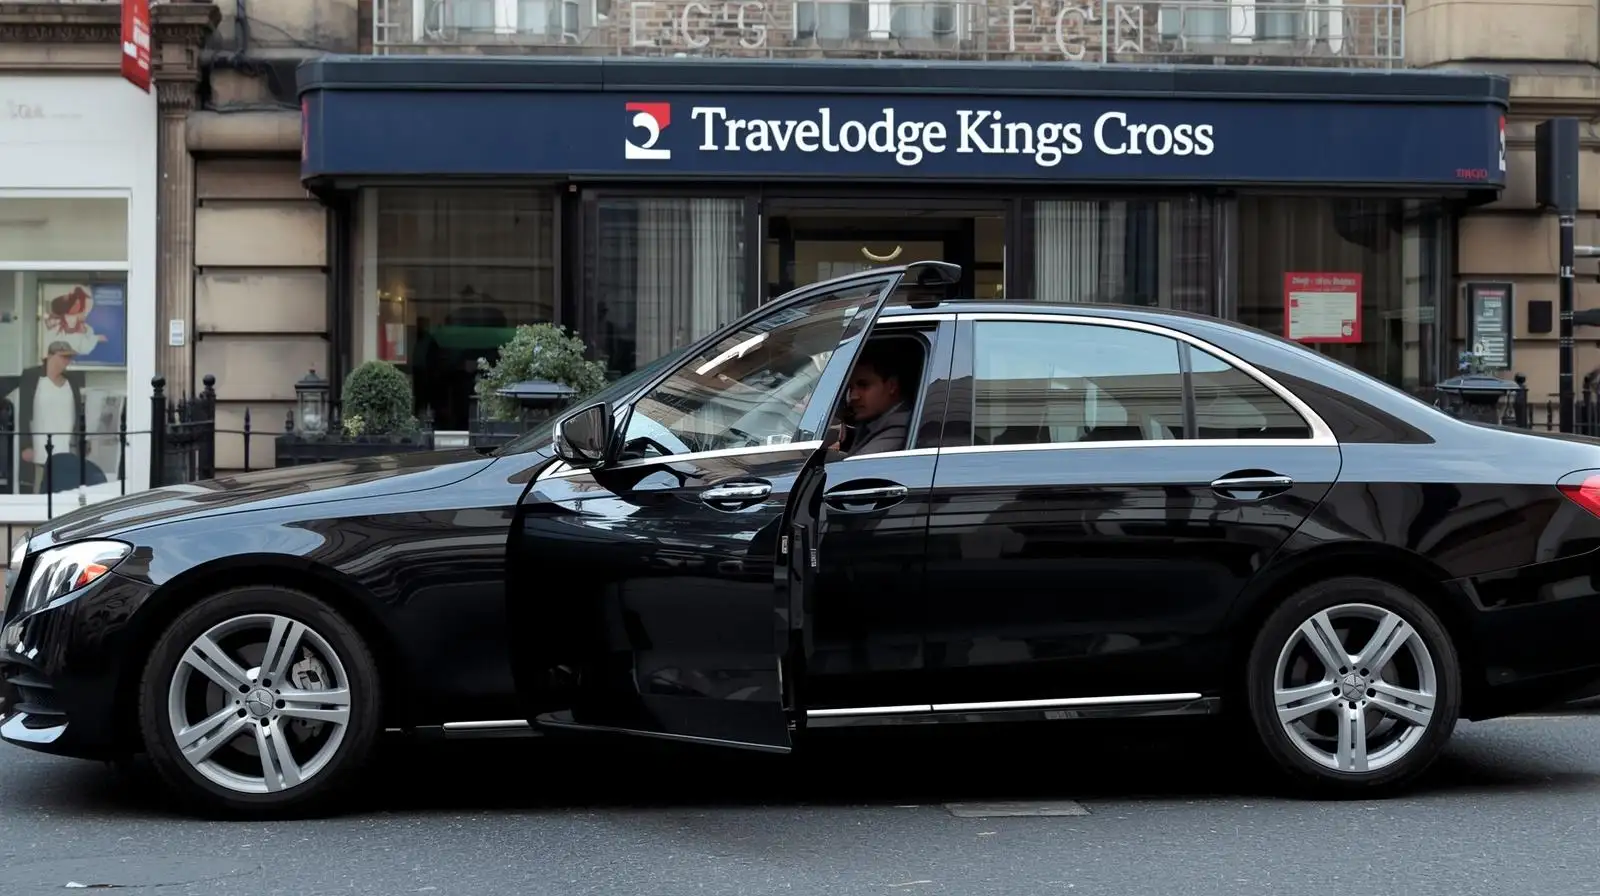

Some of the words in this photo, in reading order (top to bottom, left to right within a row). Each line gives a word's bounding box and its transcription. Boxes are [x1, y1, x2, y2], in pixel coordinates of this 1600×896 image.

[690, 105, 947, 166] Travelodge
[956, 110, 1083, 167] Kings
[1093, 111, 1215, 155] Cross
